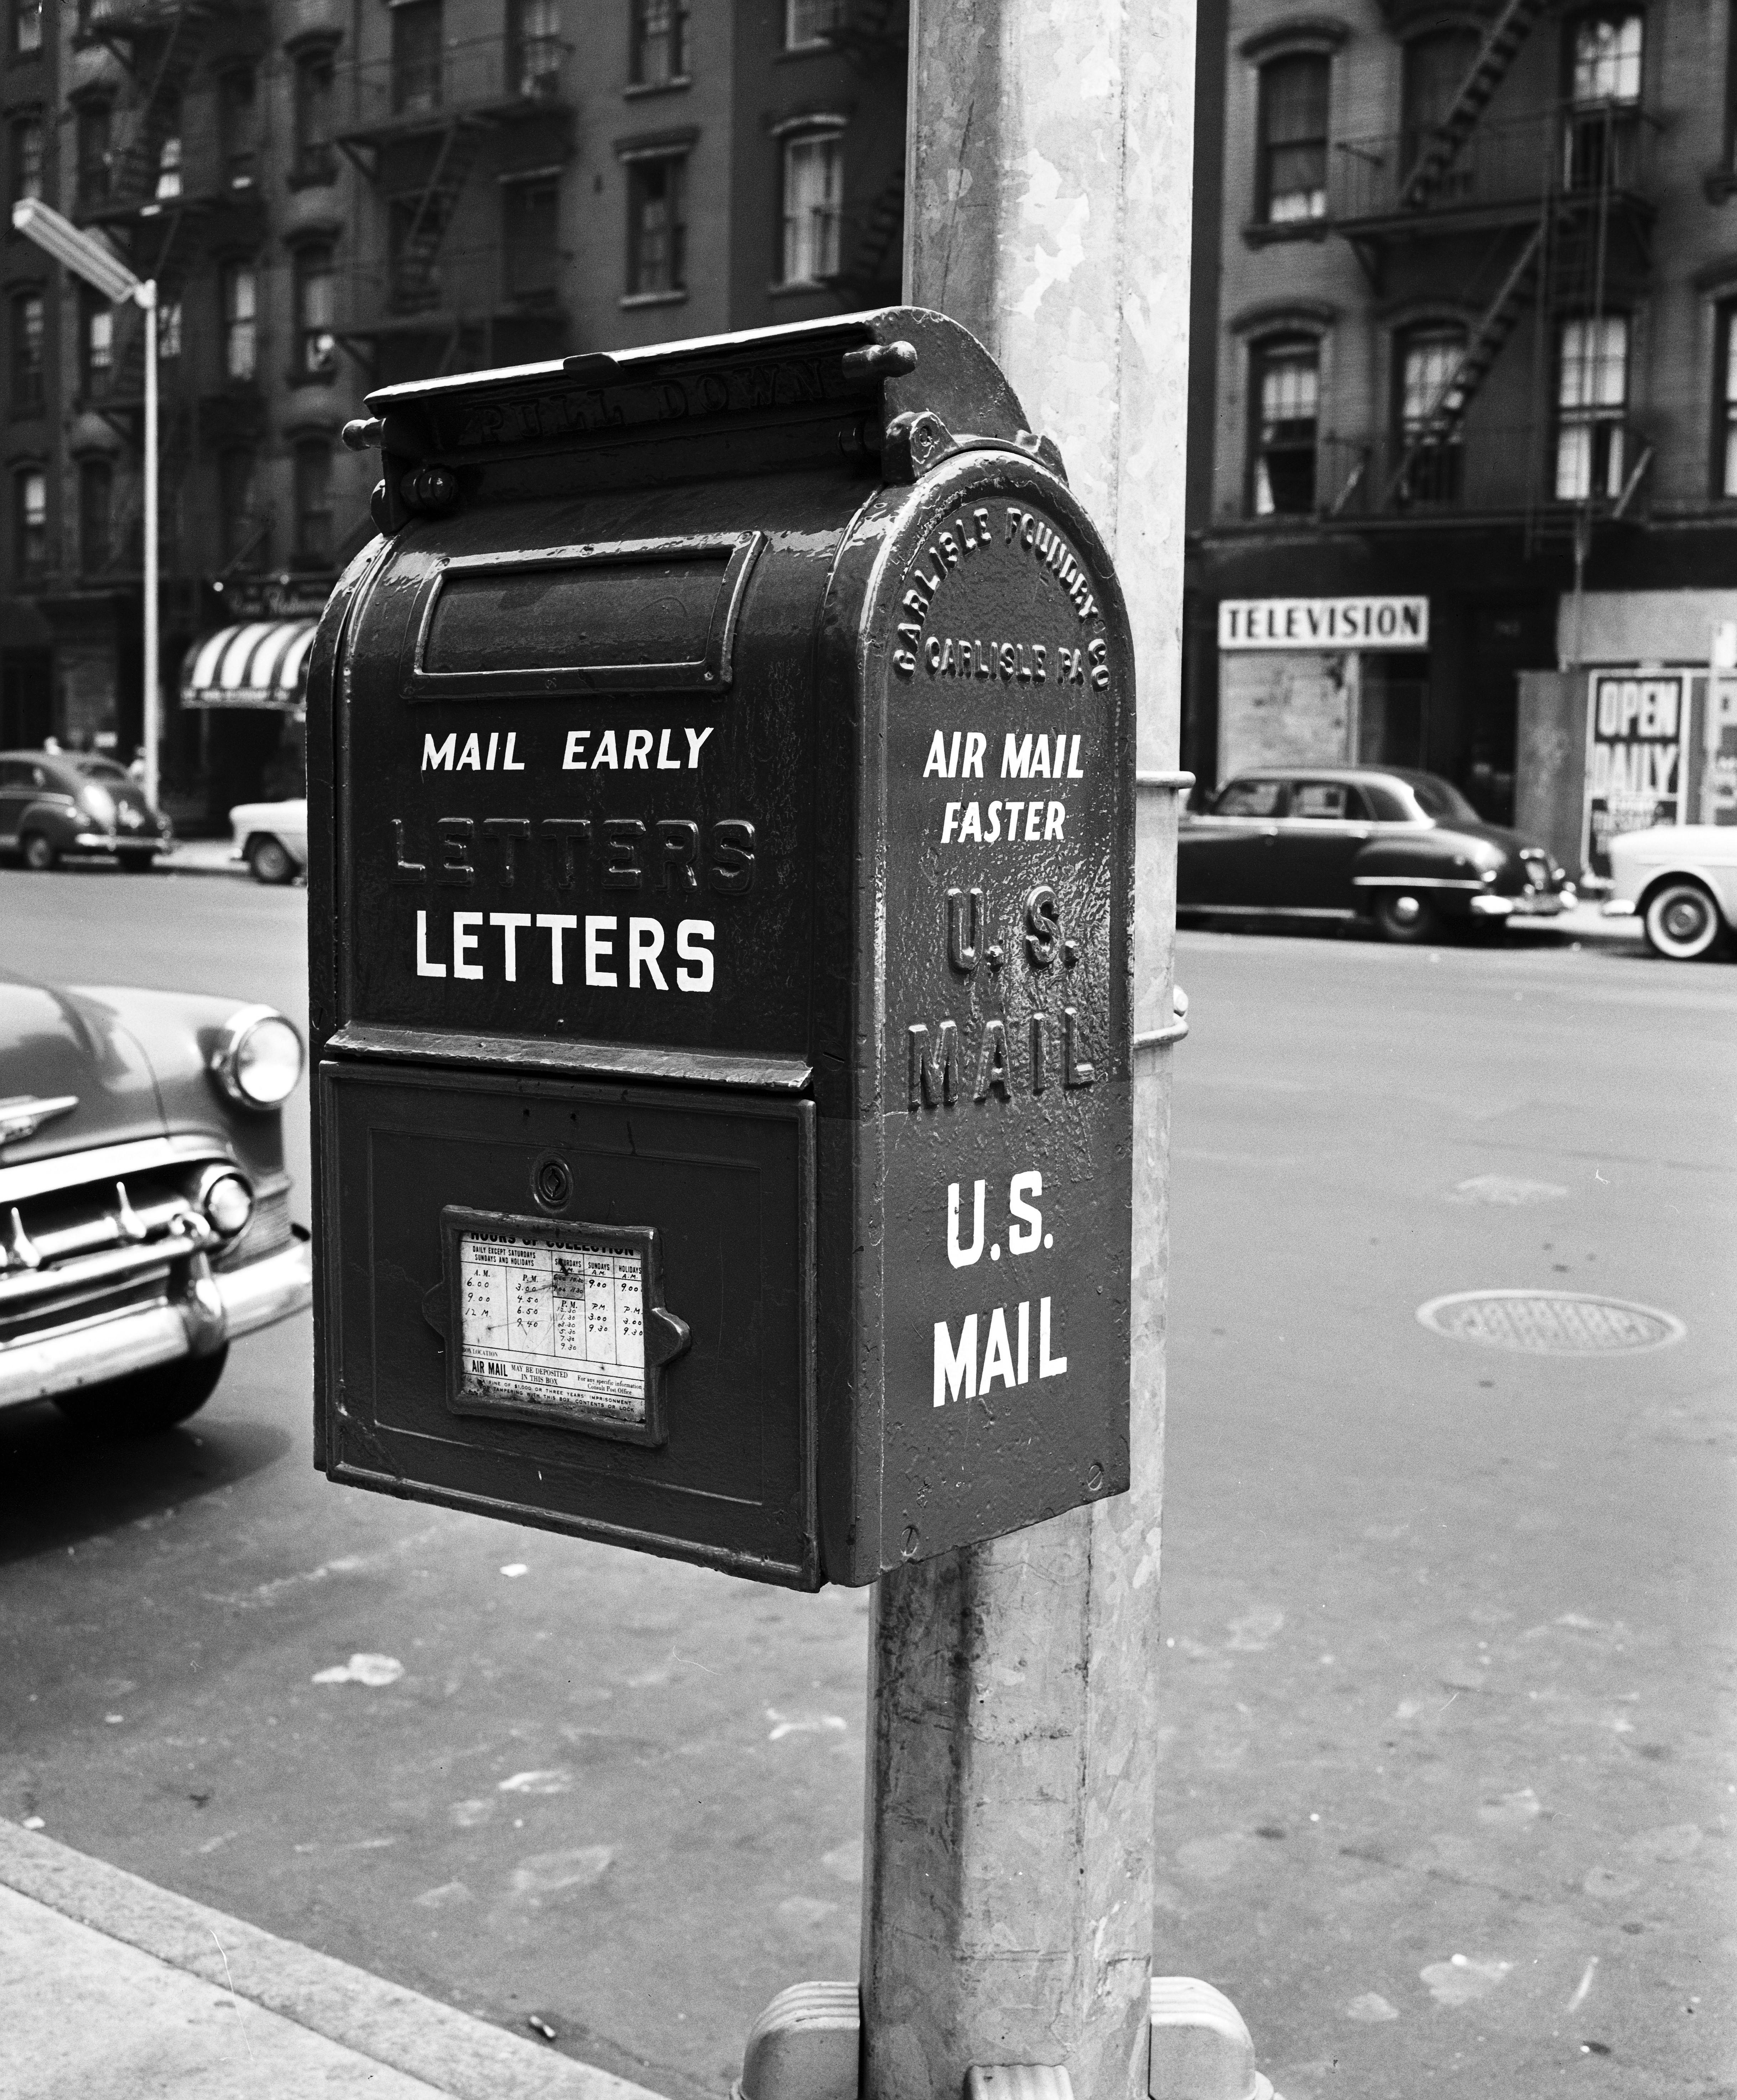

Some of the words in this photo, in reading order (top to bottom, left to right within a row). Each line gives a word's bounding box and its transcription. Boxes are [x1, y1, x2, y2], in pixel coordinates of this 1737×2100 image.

[473, 389, 626, 443] PULL
[652, 357, 827, 419] DOWN
[1229, 605, 1419, 638] TELEVISION
[926, 637, 1046, 683] CARLISLE
[1597, 680, 1679, 737] OPEN
[422, 732, 525, 770] MAIL
[562, 727, 714, 769] EARLY
[923, 729, 987, 778] AIR
[1000, 733, 1083, 778] MAIL
[1594, 743, 1678, 794] DAILY
[941, 800, 1066, 843] FASTER
[389, 818, 757, 896] LETTERS
[946, 885, 1078, 975] U.S.
[417, 910, 715, 992] LETTERS
[907, 1007, 1094, 1111] MAIL
[947, 1170, 1054, 1269] U.S.
[473, 1245, 486, 1254] DAILY
[488, 1247, 506, 1255] EXCEPT
[508, 1249, 536, 1259] SATURDAYS
[475, 1254, 496, 1262] SUNDAYS
[511, 1258, 534, 1266] HOLIDAYS
[555, 1258, 581, 1267] SURDAYS
[588, 1262, 610, 1271] SUNDAYS
[619, 1265, 641, 1274] HOLIDAYS
[472, 1348, 498, 1357] LOCATION
[472, 1360, 485, 1374] AIR
[488, 1362, 508, 1377] MAIL
[933, 1296, 1067, 1408] MAIL
[529, 1375, 544, 1383] THIS
[535, 1368, 568, 1378] DEPOSITED
[587, 1383, 605, 1391] Consult
[493, 1386, 523, 1395] TAMPERING
[575, 1399, 604, 1408] CONTENTS
[589, 1395, 632, 1406] IMPRISONMENT
